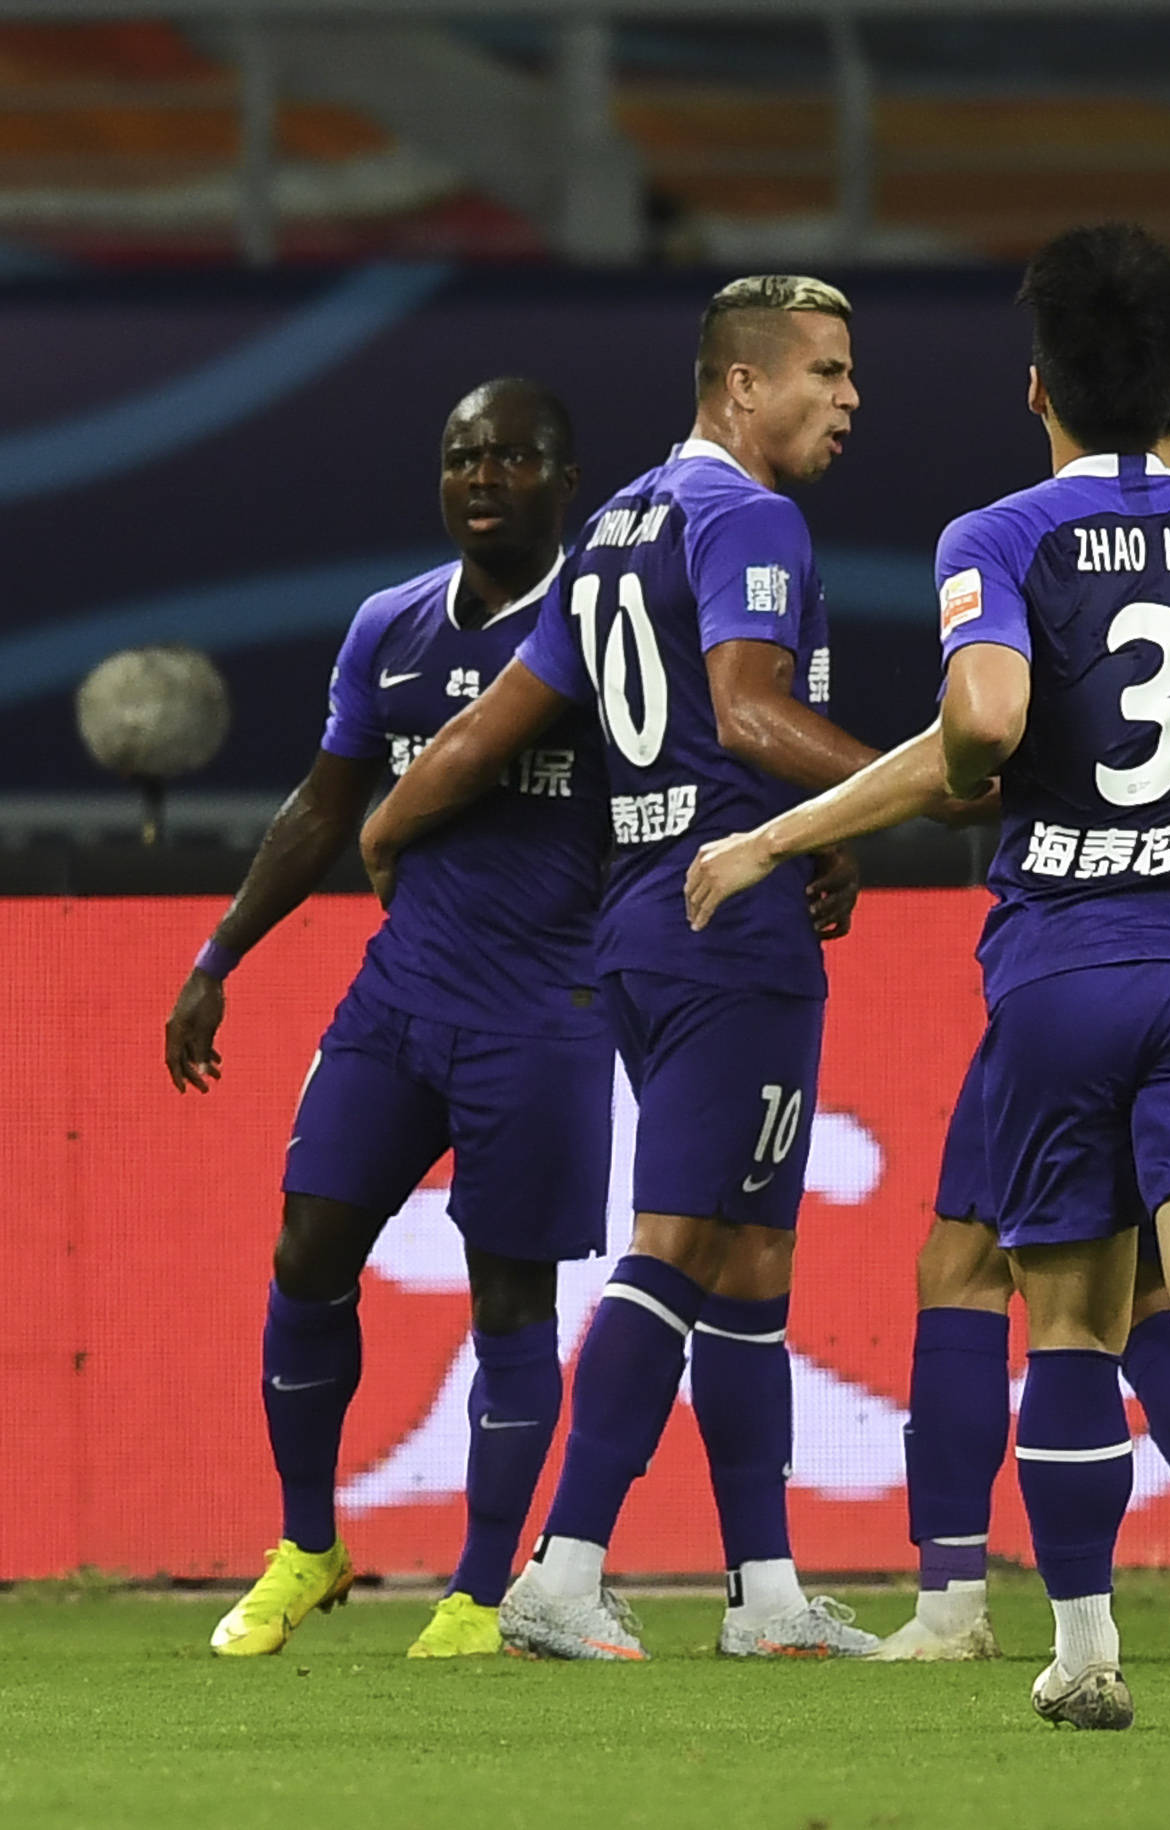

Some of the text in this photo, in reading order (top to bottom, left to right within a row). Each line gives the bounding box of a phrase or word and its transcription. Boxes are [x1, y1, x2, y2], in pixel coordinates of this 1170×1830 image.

[1073, 526, 1146, 572] ZHAO
[571, 571, 668, 767] 10
[754, 1084, 802, 1164] 10
